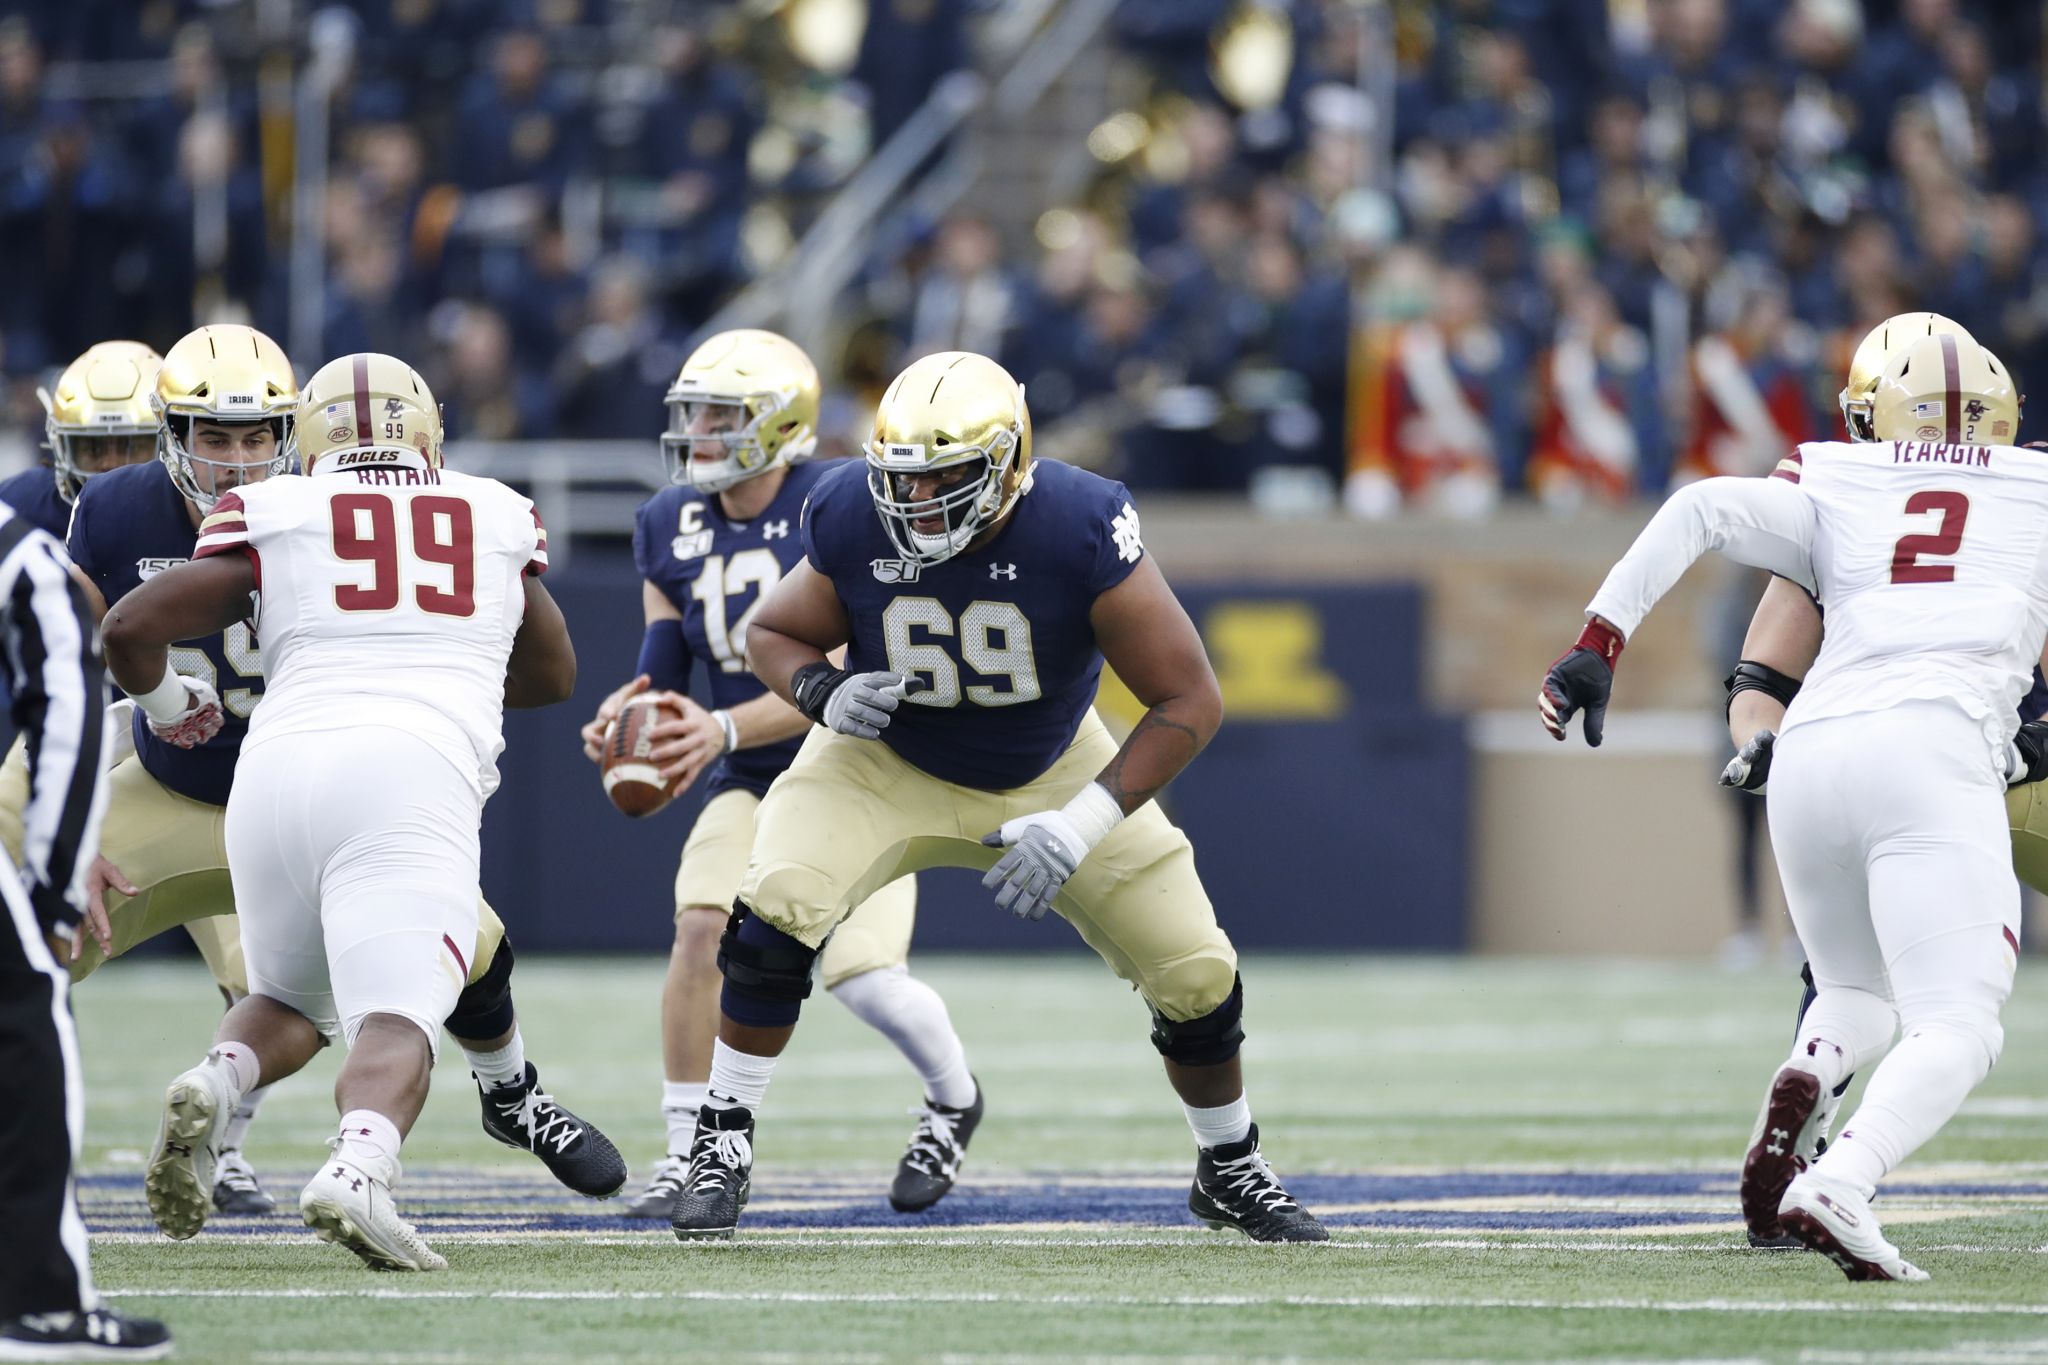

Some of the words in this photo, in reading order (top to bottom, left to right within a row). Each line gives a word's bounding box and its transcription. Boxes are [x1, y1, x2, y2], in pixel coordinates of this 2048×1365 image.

[229, 396, 253, 404] IRISH
[331, 429, 348, 440] ACC
[386, 424, 403, 439] 99
[1920, 428, 1937, 436] ACC
[1967, 425, 1975, 440] 2
[337, 451, 399, 465] EAGLES
[1894, 440, 1991, 467] YEARGIN
[680, 502, 705, 533] C
[1889, 490, 1970, 584] 2
[330, 493, 476, 617] 99
[691, 548, 781, 672] 12
[882, 595, 1041, 708] 69
